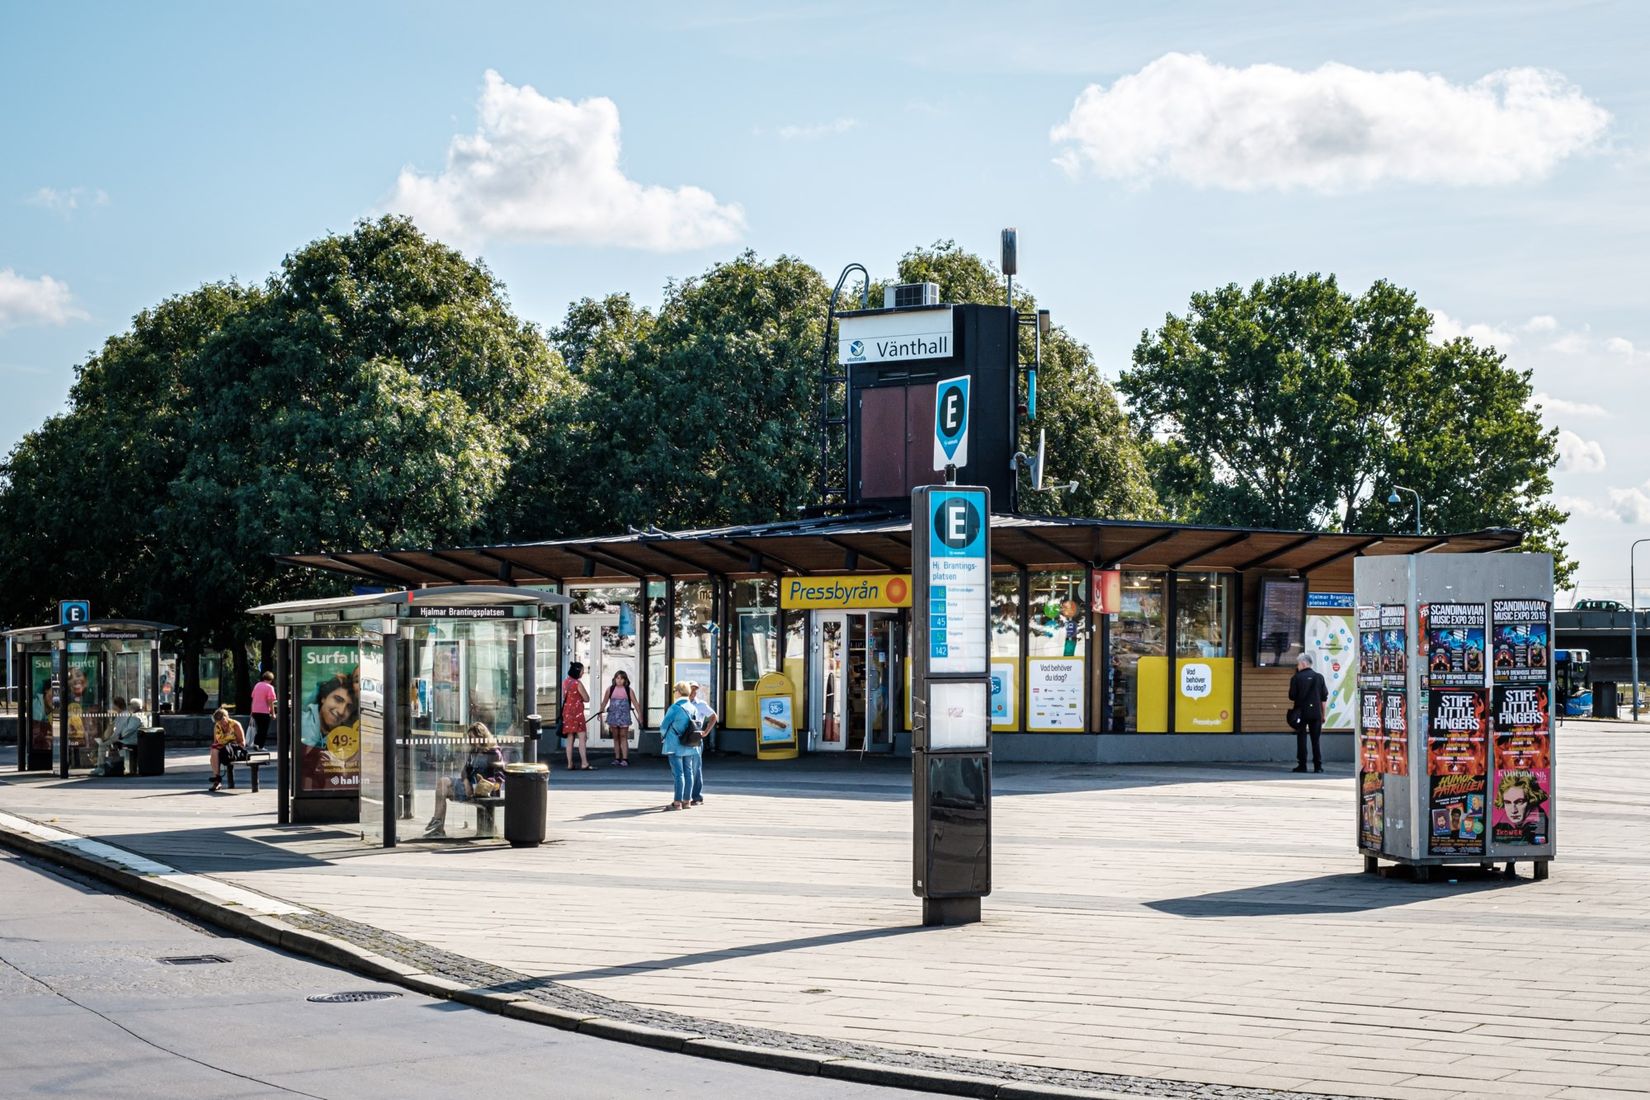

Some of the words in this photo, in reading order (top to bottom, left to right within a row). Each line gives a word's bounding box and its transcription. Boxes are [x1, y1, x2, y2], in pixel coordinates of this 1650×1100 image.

[877, 336, 947, 358] Vänthall
[946, 394, 958, 429] E
[949, 507, 966, 540] E
[943, 561, 978, 572] Brantings-
[932, 572, 957, 581] platsen
[790, 580, 879, 605] Pressbyrån
[1430, 605, 1484, 616] SCANDINAVIAN
[1494, 601, 1548, 611] SCANDINAVIAN
[71, 608, 79, 621] E
[420, 607, 446, 617] Hjalmar
[448, 607, 505, 618] Brantingsplatsen
[1494, 611, 1514, 621] MUSIC
[1514, 611, 1530, 621] EXPO
[1531, 611, 1547, 620] 2019
[936, 617, 946, 626] 45
[1430, 616, 1451, 625] MUSIC
[1452, 616, 1468, 624] EXPO
[1468, 616, 1484, 624] 2019
[935, 646, 947, 656] 142
[307, 650, 348, 664] Surfa
[68, 659, 95, 669] ugnt!
[1040, 664, 1051, 672] Vad
[1051, 664, 1072, 672] behöver
[1053, 674, 1068, 683] idag?
[1364, 695, 1377, 706] STIFF
[1388, 696, 1401, 707] STIFF
[1441, 696, 1473, 707] STIFF
[1505, 690, 1536, 702] STIFF
[770, 704, 783, 713] 35:-
[1362, 706, 1378, 717] LITTLE
[1386, 706, 1402, 718] LITTLE
[1438, 707, 1474, 718] LITTLE
[1502, 701, 1538, 713] LITTLE
[1499, 712, 1544, 724] FINGERS
[1434, 718, 1480, 730] FINGERS
[332, 734, 357, 747] 49:-
[1438, 775, 1476, 787] HUMOR
[1433, 781, 1485, 797] PATRULLEN
